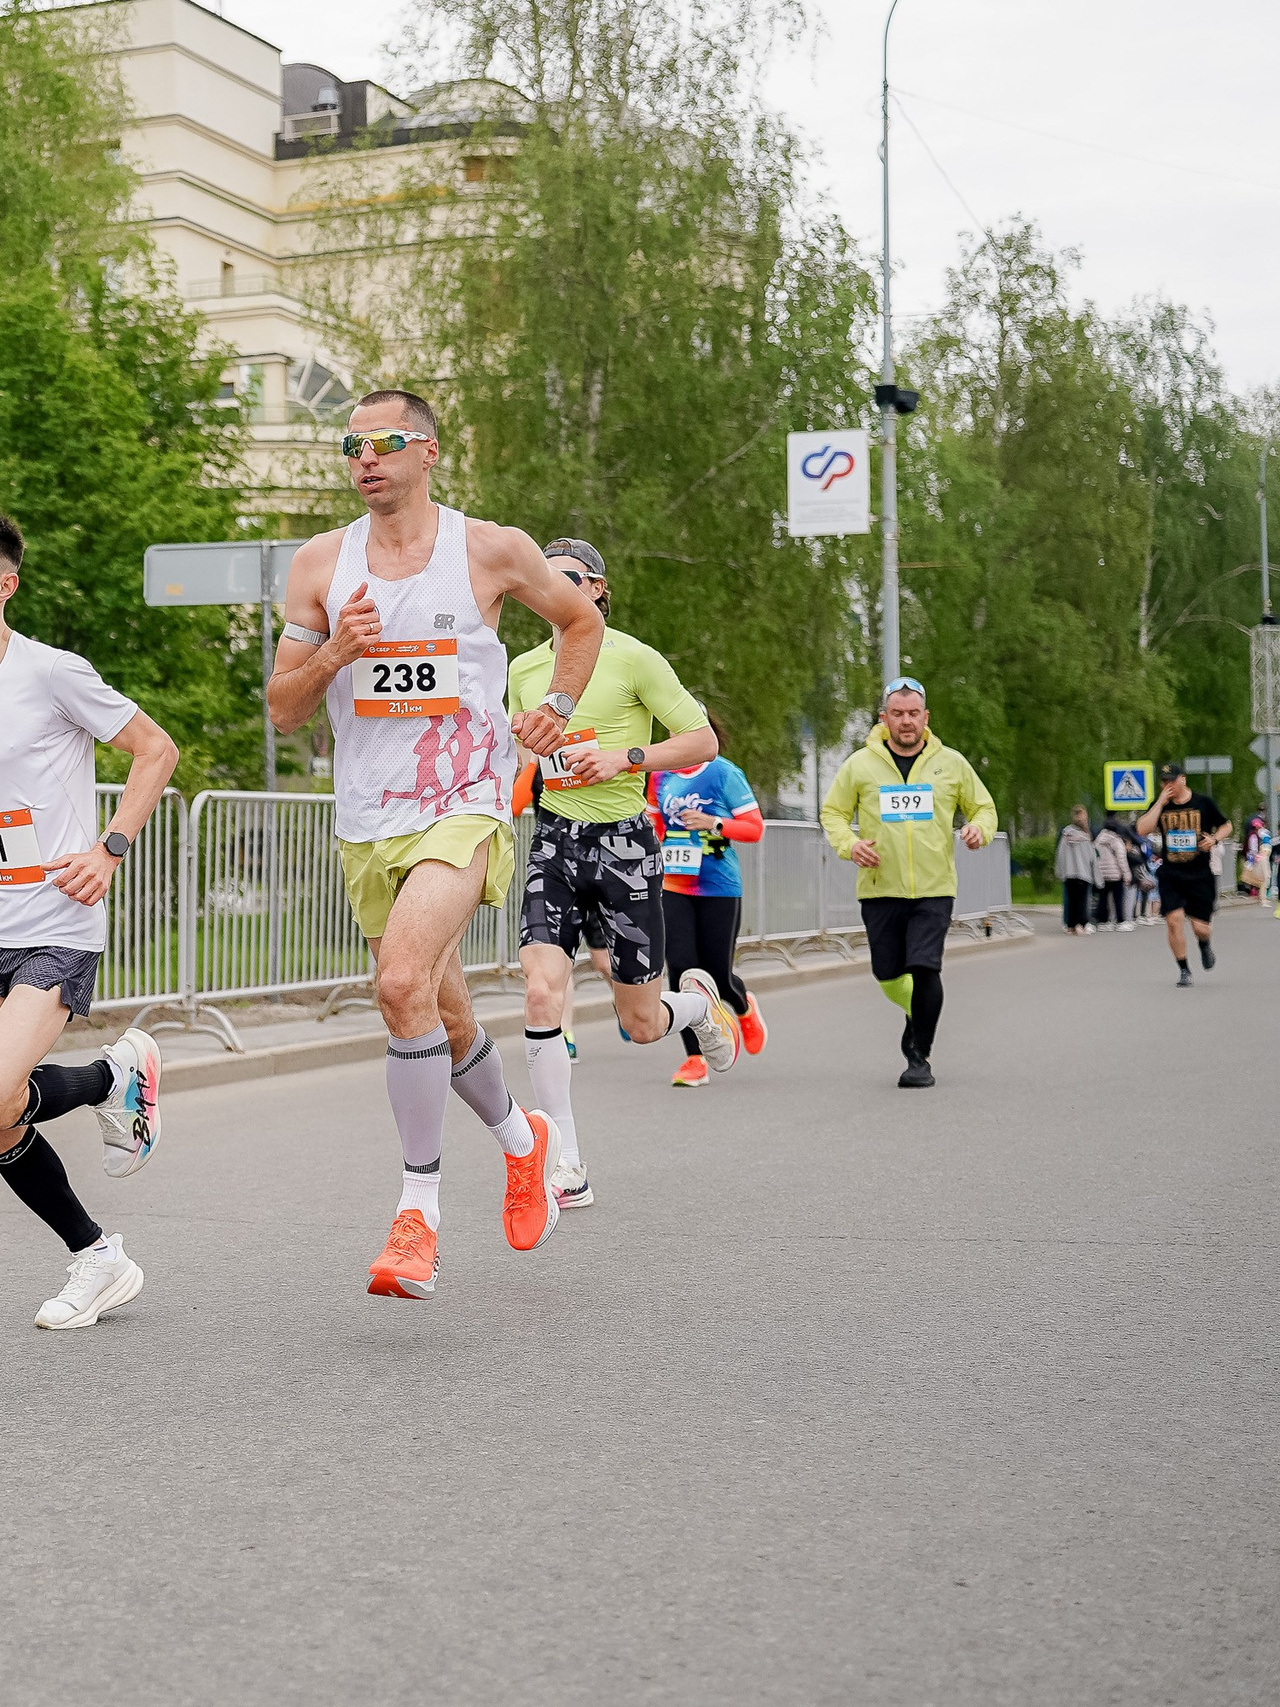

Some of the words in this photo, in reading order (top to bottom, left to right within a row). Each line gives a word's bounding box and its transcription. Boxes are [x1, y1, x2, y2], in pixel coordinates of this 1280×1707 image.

[372, 662, 437, 693] 238
[891, 795, 922, 810] 599
[665, 850, 691, 863] 815
